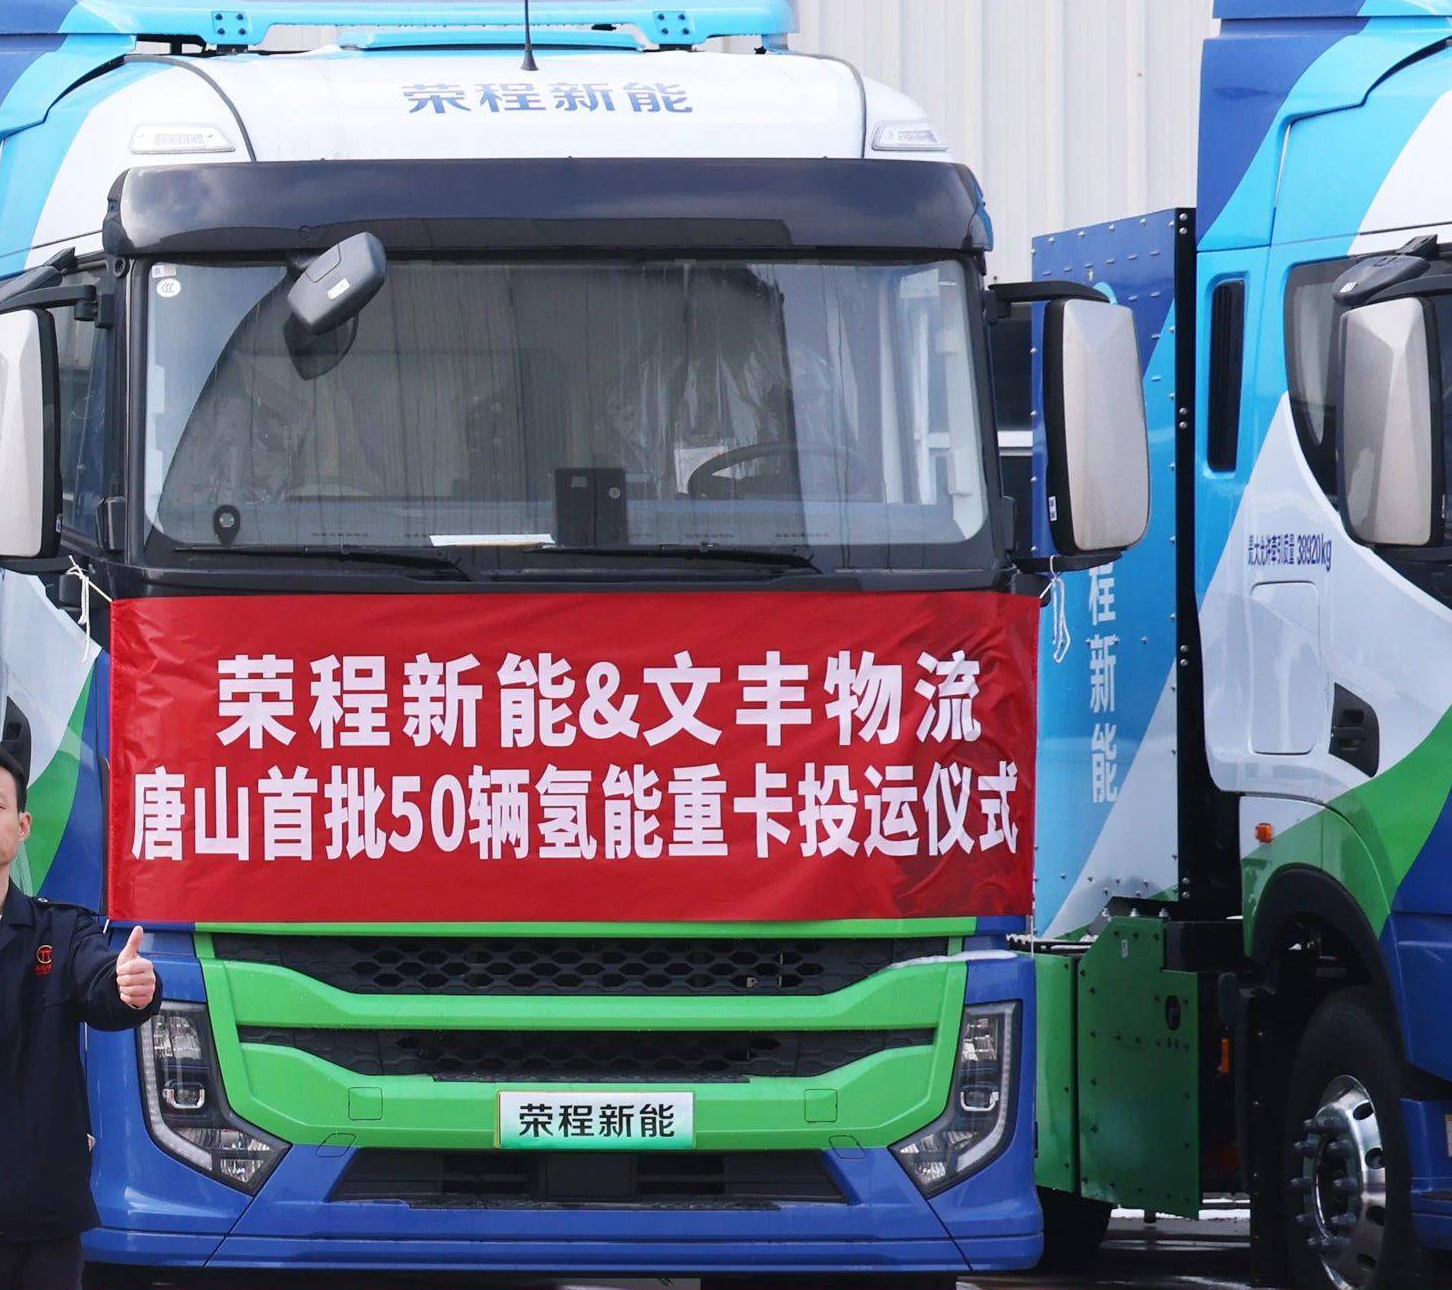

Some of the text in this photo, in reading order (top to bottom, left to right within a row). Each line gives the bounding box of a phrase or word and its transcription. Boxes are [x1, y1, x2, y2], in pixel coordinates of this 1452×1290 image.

[401, 82, 694, 116] 荣程新能
[216, 650, 982, 750] 荣程新能&文丰物流
[1088, 561, 1119, 806] 程新能
[131, 760, 1019, 862] 唐山首批50辆氢能重卡投运仪式
[518, 1103, 676, 1139] 荣程新能
